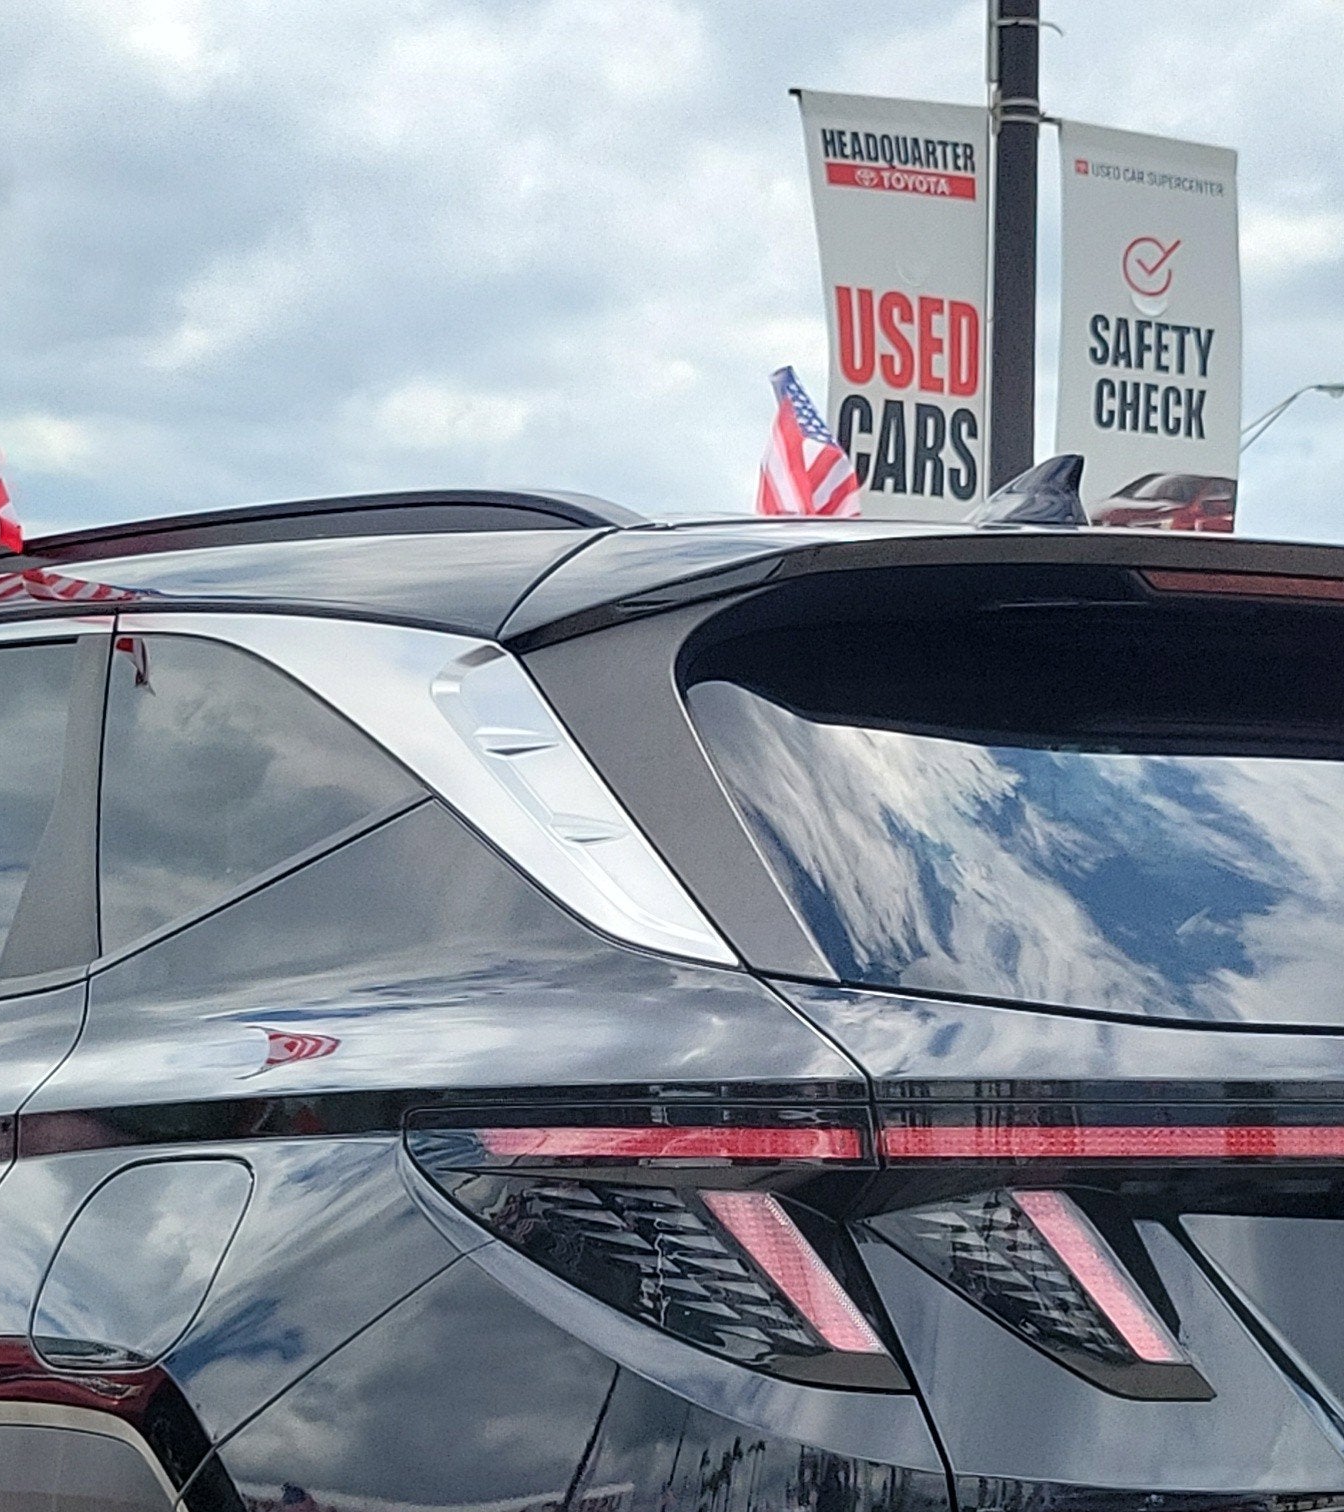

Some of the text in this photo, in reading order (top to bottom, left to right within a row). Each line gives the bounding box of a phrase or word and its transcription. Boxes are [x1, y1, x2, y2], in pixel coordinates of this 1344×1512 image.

[821, 128, 976, 173] HEADQUARTER
[1091, 163, 1224, 198] USED CAR SUPERCENTER
[881, 171, 950, 196] TOYOTA
[834, 285, 980, 398] USED
[1088, 313, 1215, 379] SAFETY
[1093, 377, 1207, 440] CHECK
[836, 393, 979, 502] CARS
